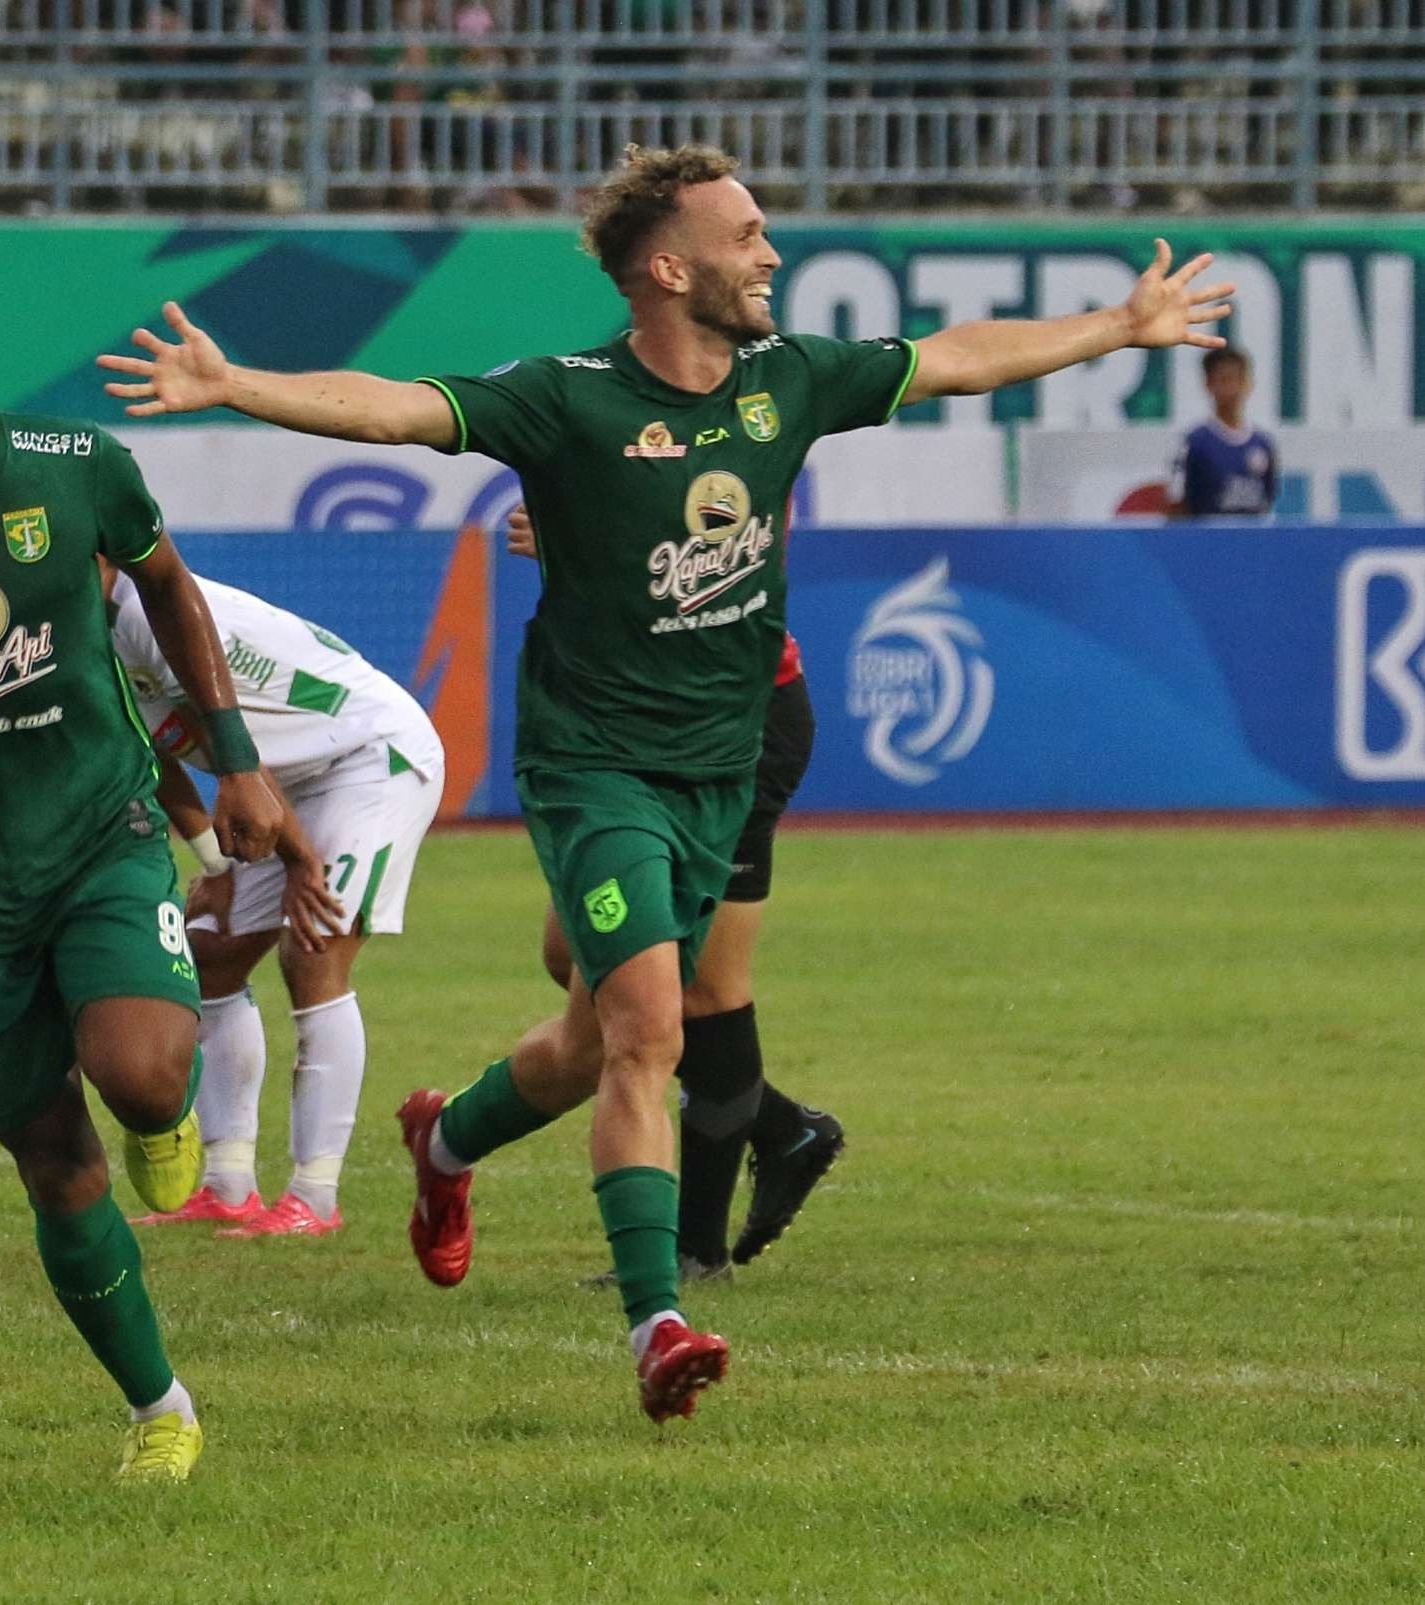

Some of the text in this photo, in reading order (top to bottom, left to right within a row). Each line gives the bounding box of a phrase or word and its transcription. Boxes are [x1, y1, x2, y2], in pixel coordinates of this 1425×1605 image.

[11, 430, 71, 446] KINGS
[12, 440, 71, 455] WALLET
[648, 535, 735, 600] Kapal
